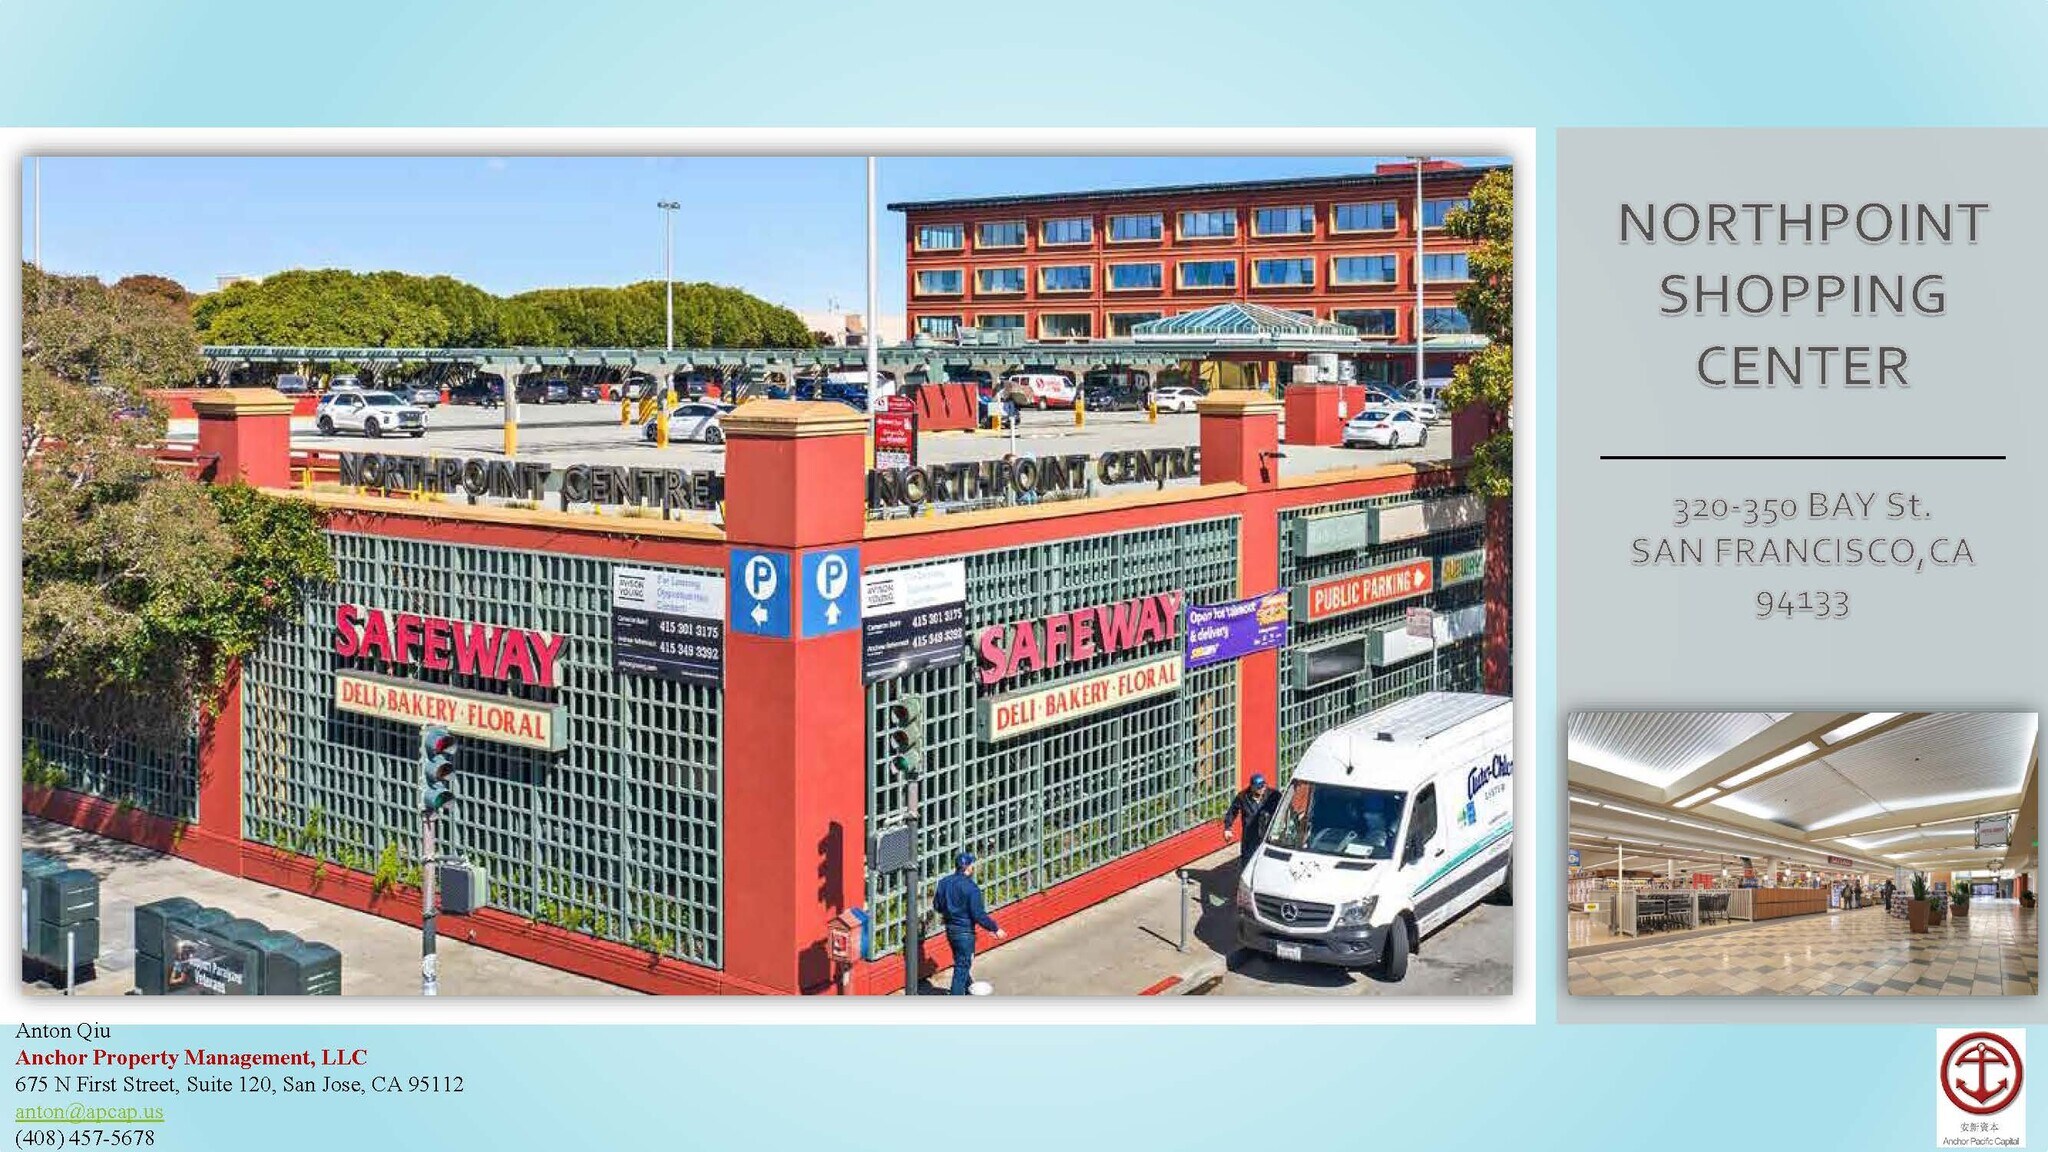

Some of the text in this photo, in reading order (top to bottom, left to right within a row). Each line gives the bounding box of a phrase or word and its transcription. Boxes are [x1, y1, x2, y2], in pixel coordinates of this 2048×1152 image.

[340, 452, 717, 510] NORTHPOINT CENTRE
[867, 446, 1200, 508] NORTHPOINT CENTRE
[1314, 570, 1412, 613] PUBLIC PARKING
[660, 621, 676, 634] 415
[694, 625, 719, 639] 3175
[912, 615, 928, 628] 415
[979, 590, 1184, 685] SAFEWAY
[1190, 609, 1213, 626] Open
[1197, 626, 1229, 640] delivery
[335, 603, 566, 688] SAFEWAY
[660, 641, 676, 654] 415
[912, 634, 928, 648] 415
[342, 681, 546, 742] DELI BAKERY FLORAL
[996, 662, 1178, 731] DELI BAKERY FLORAL
